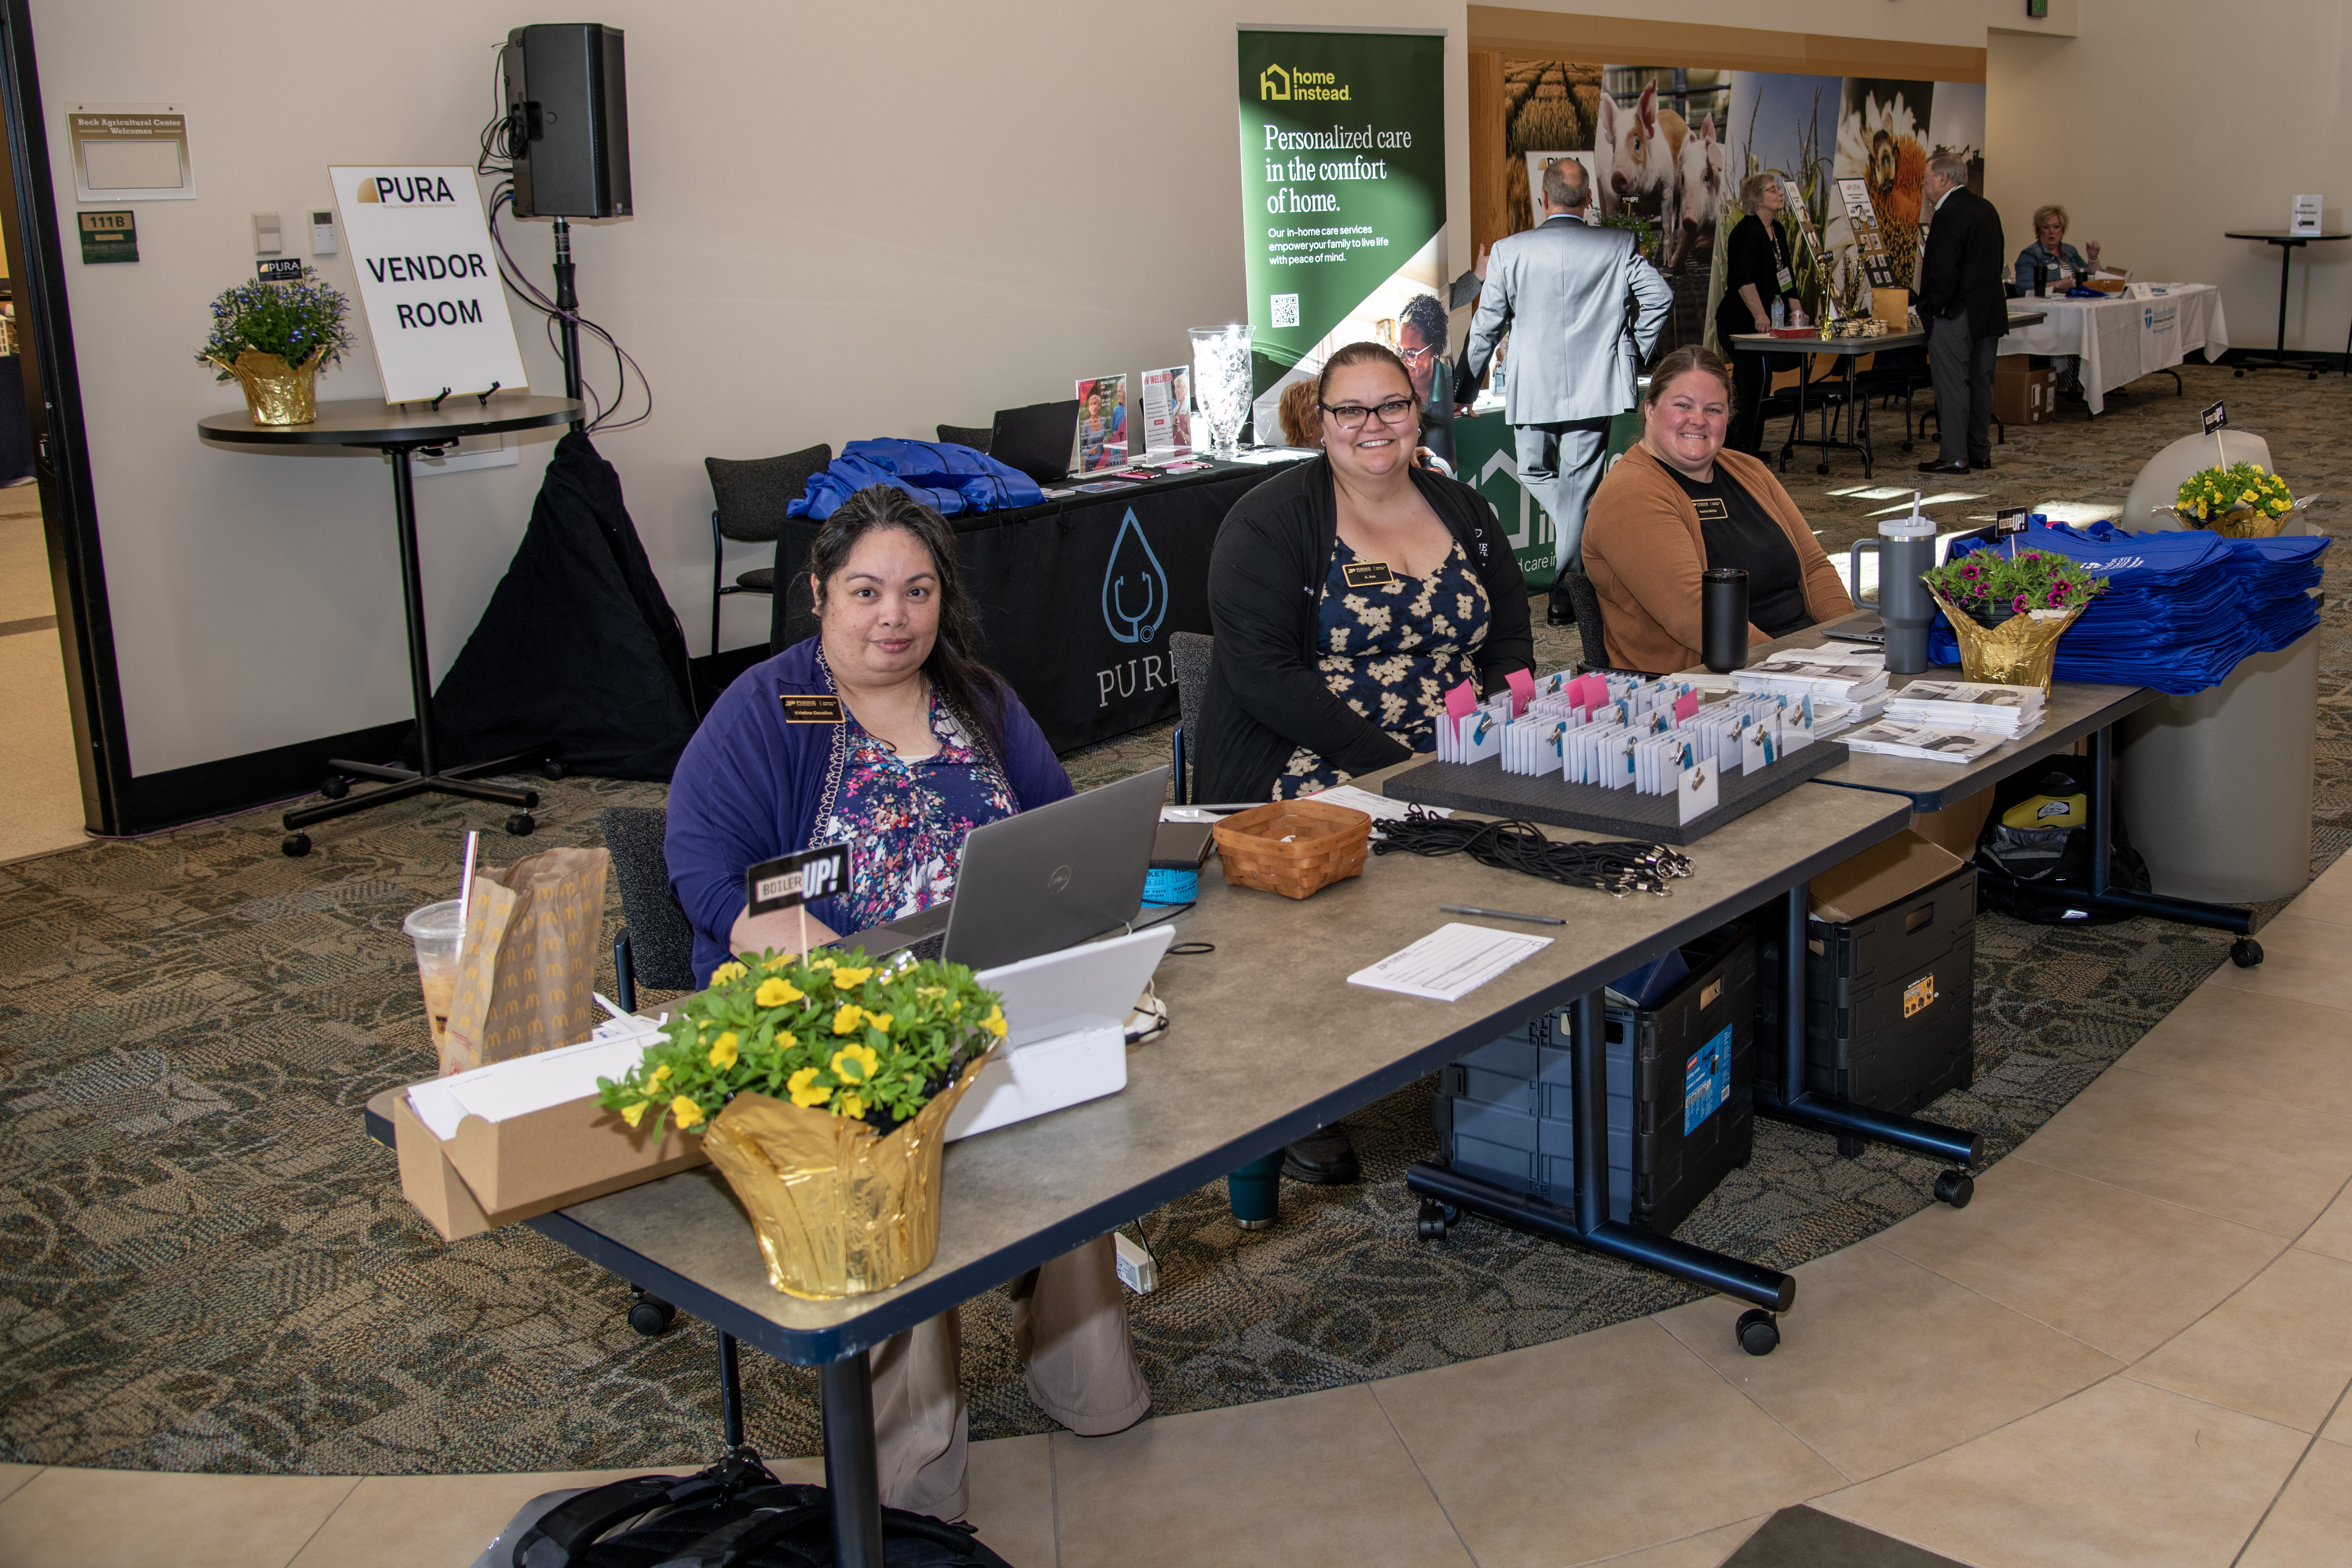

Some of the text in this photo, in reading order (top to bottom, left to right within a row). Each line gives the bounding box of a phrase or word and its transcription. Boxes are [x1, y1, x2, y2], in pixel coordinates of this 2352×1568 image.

[1293, 66, 1335, 84] home
[1294, 84, 1352, 100] instead.
[101, 119, 152, 127] Agricultural
[1263, 124, 1412, 150] Personalized care
[1265, 155, 1387, 182] in the comfort
[376, 176, 456, 203] PURA
[1267, 187, 1340, 214] of home.
[90, 216, 125, 228] 111B
[1268, 225, 1372, 238] Our in-home care services
[1269, 237, 1389, 252] empower your family to live life
[269, 261, 300, 272] PURA
[1269, 252, 1346, 266] with peace of mind.
[366, 253, 487, 283] VENDOR
[396, 299, 483, 329] ROOM
[1145, 373, 1173, 385] IV WELLNESS
[1145, 383, 1171, 398] HYDRATE
[2013, 513, 2025, 531] UP!
[1524, 557, 1548, 572] care
[763, 855, 841, 900] BOILER UP!
[1177, 885, 1196, 895] COUPON
[1908, 979, 1920, 989] OLYMPIA
[1688, 1057, 1697, 1070] STAPLES
